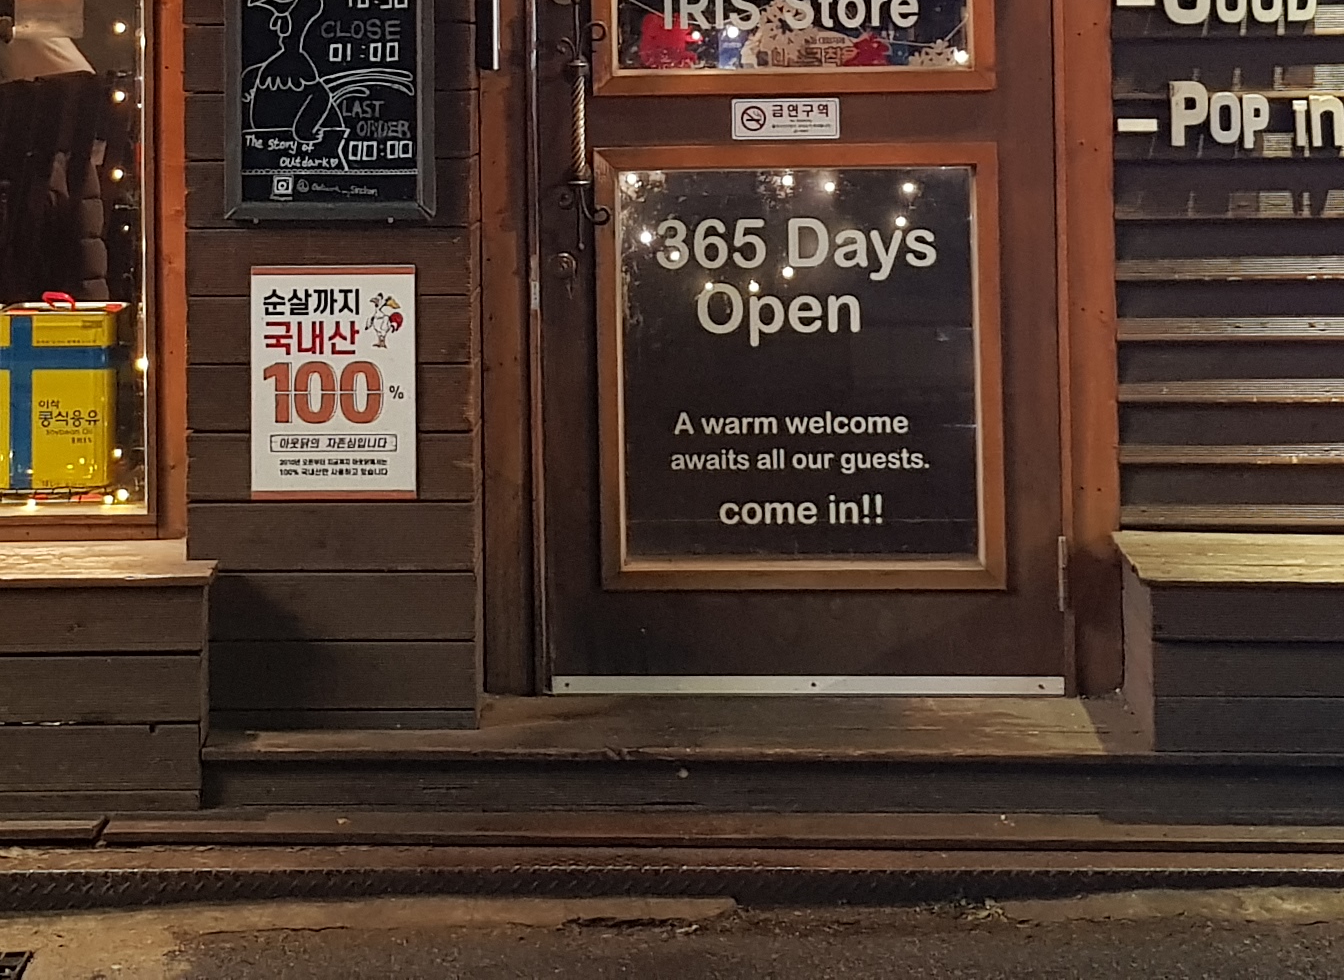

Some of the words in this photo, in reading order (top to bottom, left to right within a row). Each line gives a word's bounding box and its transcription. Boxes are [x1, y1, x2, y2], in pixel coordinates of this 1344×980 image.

[321, 20, 401, 39] CLOSE
[329, 42, 399, 62] 01:00
[342, 100, 384, 118] LAST
[771, 104, 829, 118] 금연구역
[356, 120, 410, 138] ORDER
[245, 135, 264, 149] The
[301, 142, 315, 153] of
[348, 140, 413, 161] 00:00
[657, 217, 767, 270] 365
[786, 217, 937, 281] Days
[263, 288, 360, 316] 순살까지
[697, 282, 861, 347] Open
[264, 320, 360, 356] 국내산
[263, 360, 384, 425] 100
[389, 385, 405, 400] %
[38, 409, 101, 428] 콩식용유
[674, 412, 695, 435] A
[700, 415, 778, 435] warm
[785, 411, 909, 435] welcome
[670, 448, 750, 470] awaits
[756, 448, 785, 469] all
[792, 451, 834, 469] our
[840, 448, 931, 474] guests.
[719, 501, 817, 525] come
[828, 494, 884, 525] in!!
